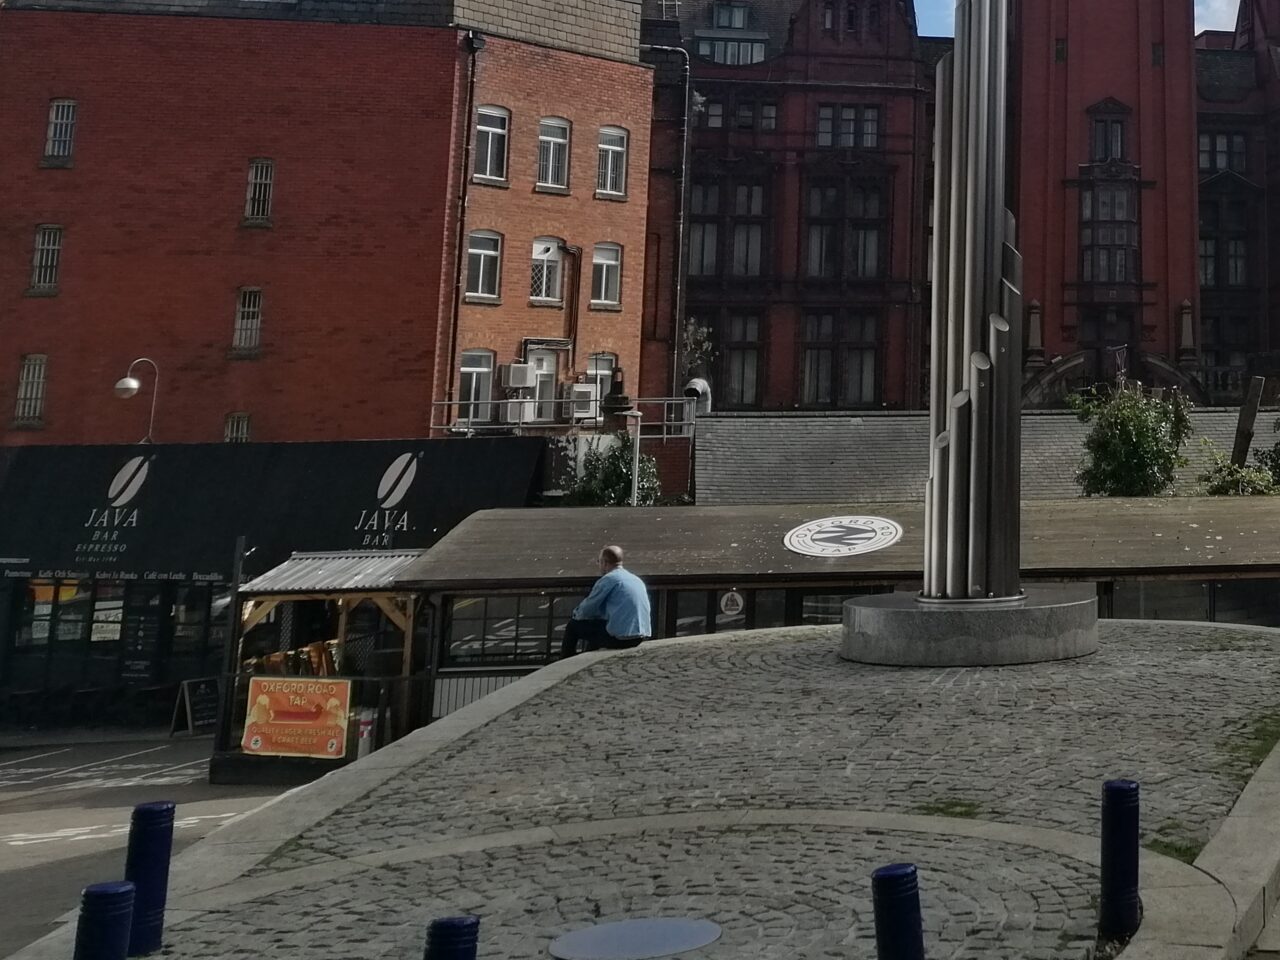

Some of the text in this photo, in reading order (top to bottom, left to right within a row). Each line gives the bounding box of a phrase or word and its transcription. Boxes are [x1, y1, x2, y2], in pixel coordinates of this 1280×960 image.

[83, 508, 138, 528] JAVA
[354, 510, 408, 531] JAVA
[91, 530, 119, 541] BAR
[795, 519, 875, 539] OXFORD
[362, 534, 390, 546] BAR
[75, 543, 127, 552] ESPRESSO
[261, 681, 337, 695] OXFORD ROAD
[289, 695, 308, 706] TAP
